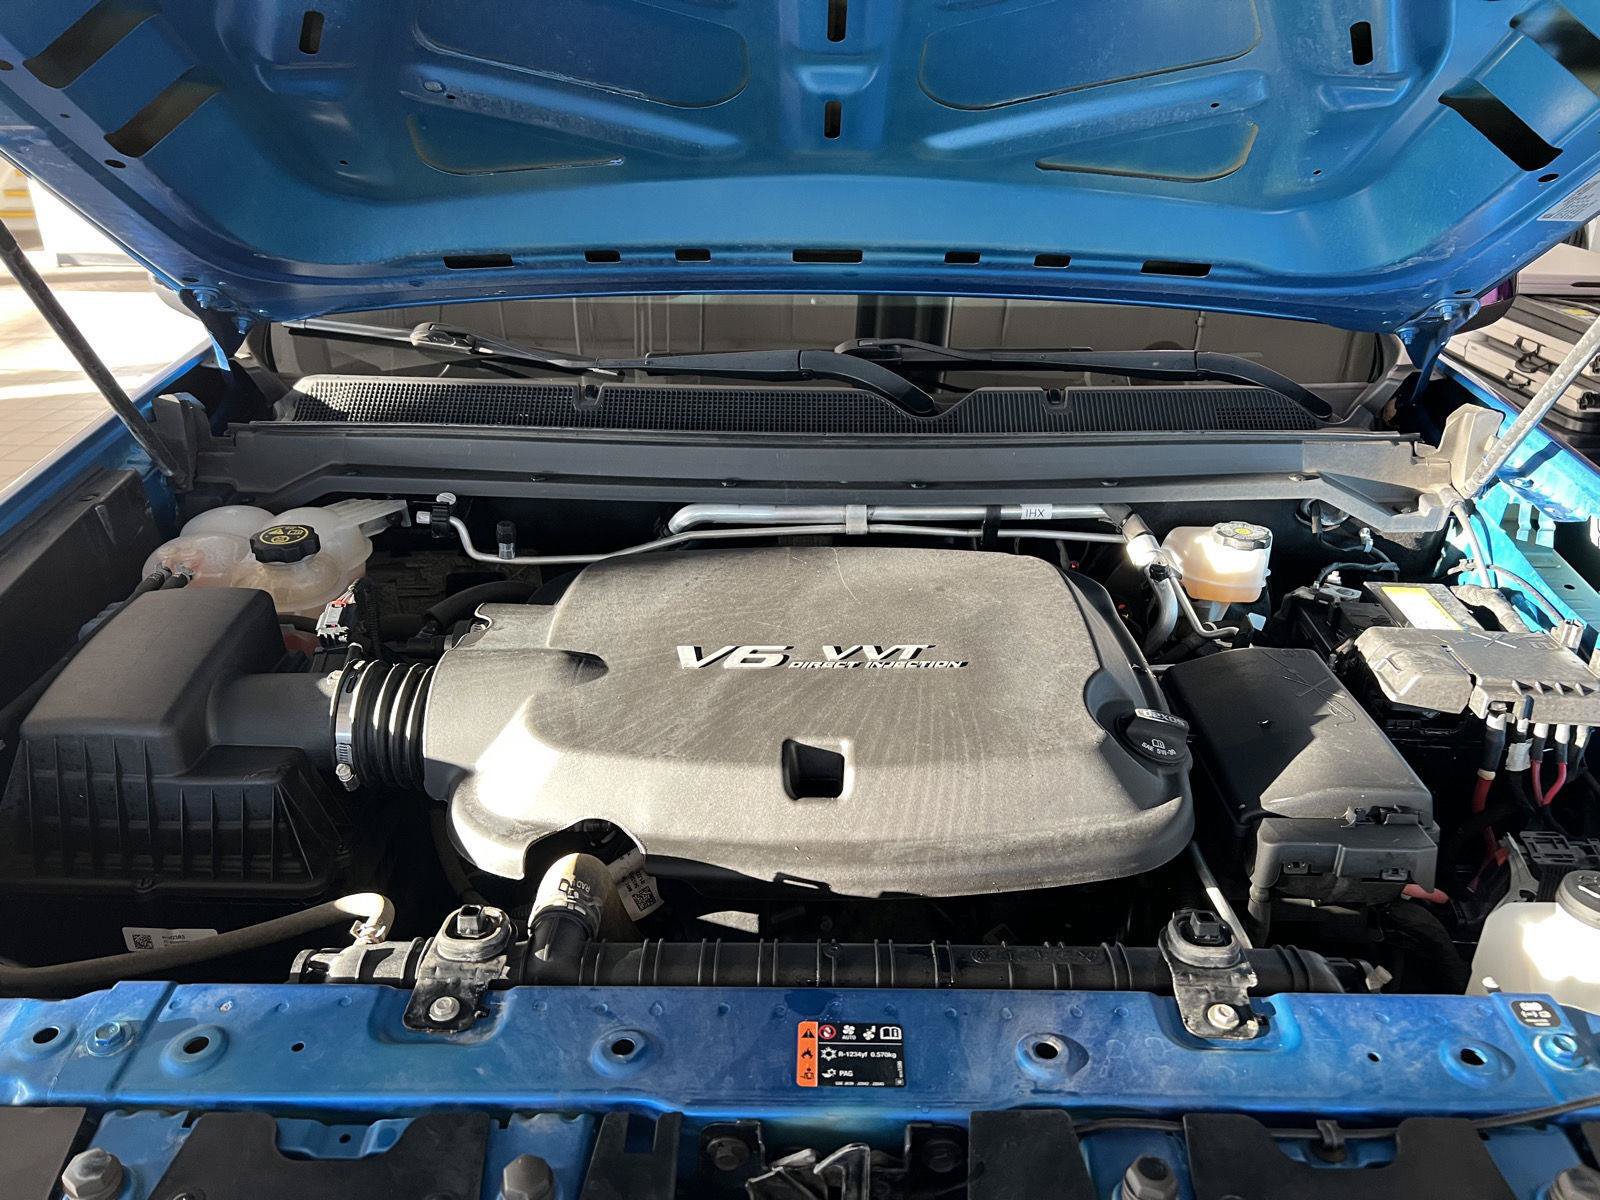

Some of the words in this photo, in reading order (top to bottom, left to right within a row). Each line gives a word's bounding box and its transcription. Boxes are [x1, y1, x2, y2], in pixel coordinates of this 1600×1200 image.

[677, 645, 794, 669] V6
[822, 644, 936, 660] VVT
[788, 661, 864, 669] DIRECT
[864, 661, 968, 669] INJECTION
[838, 1051, 868, 1059] R-1234yf
[870, 1051, 897, 1059] 0.570kg
